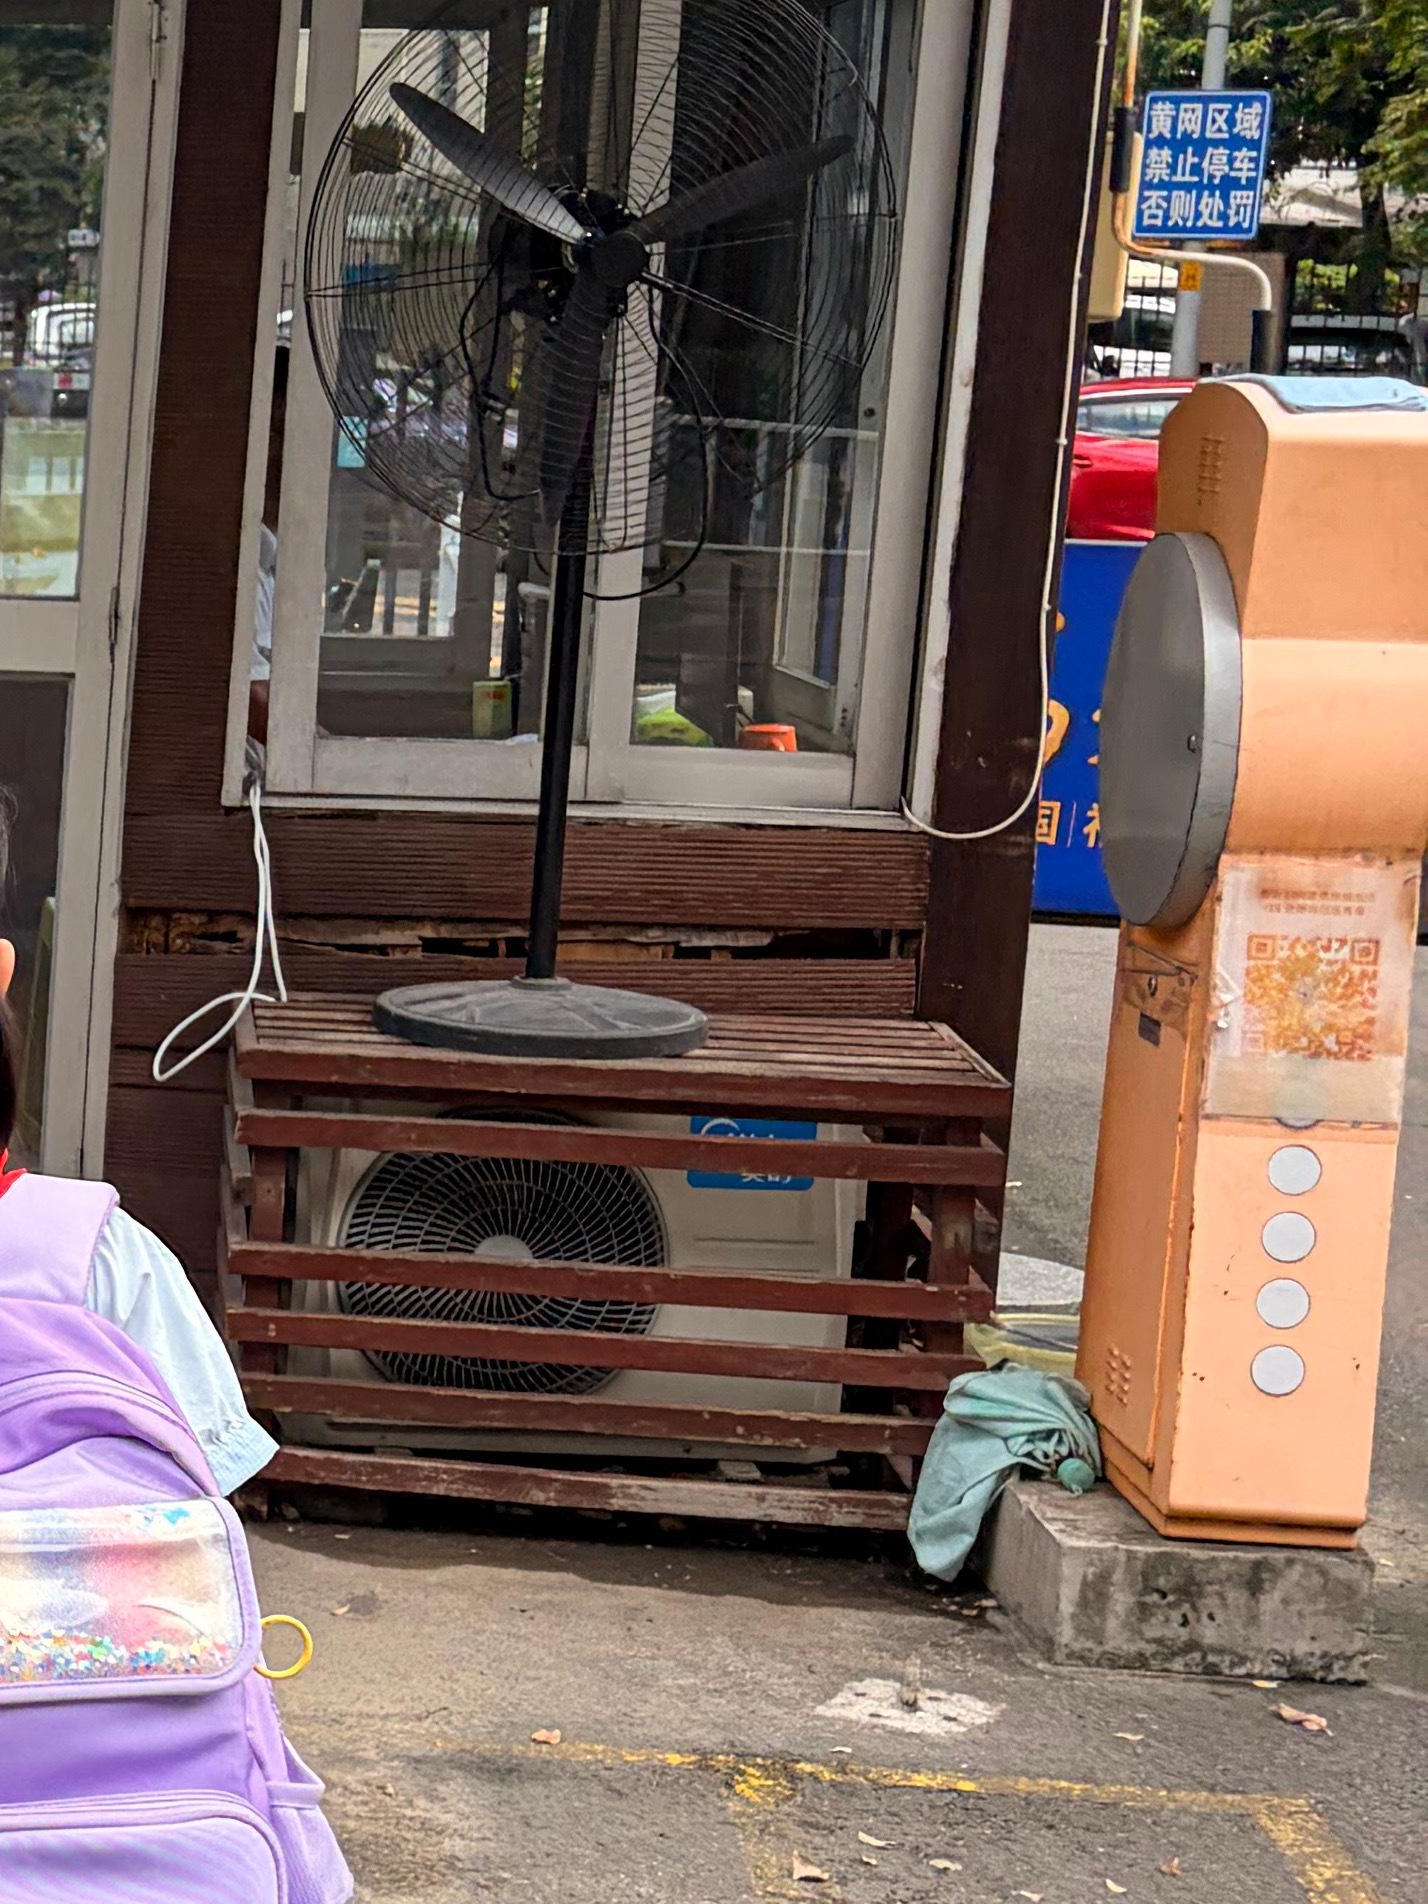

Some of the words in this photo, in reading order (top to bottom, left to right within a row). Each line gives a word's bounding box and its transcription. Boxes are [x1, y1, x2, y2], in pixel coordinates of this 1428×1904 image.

[1148, 100, 1263, 140] 黄网区域
[1144, 145, 1258, 185] 禁止停车
[1140, 189, 1255, 229] 否则处罚
